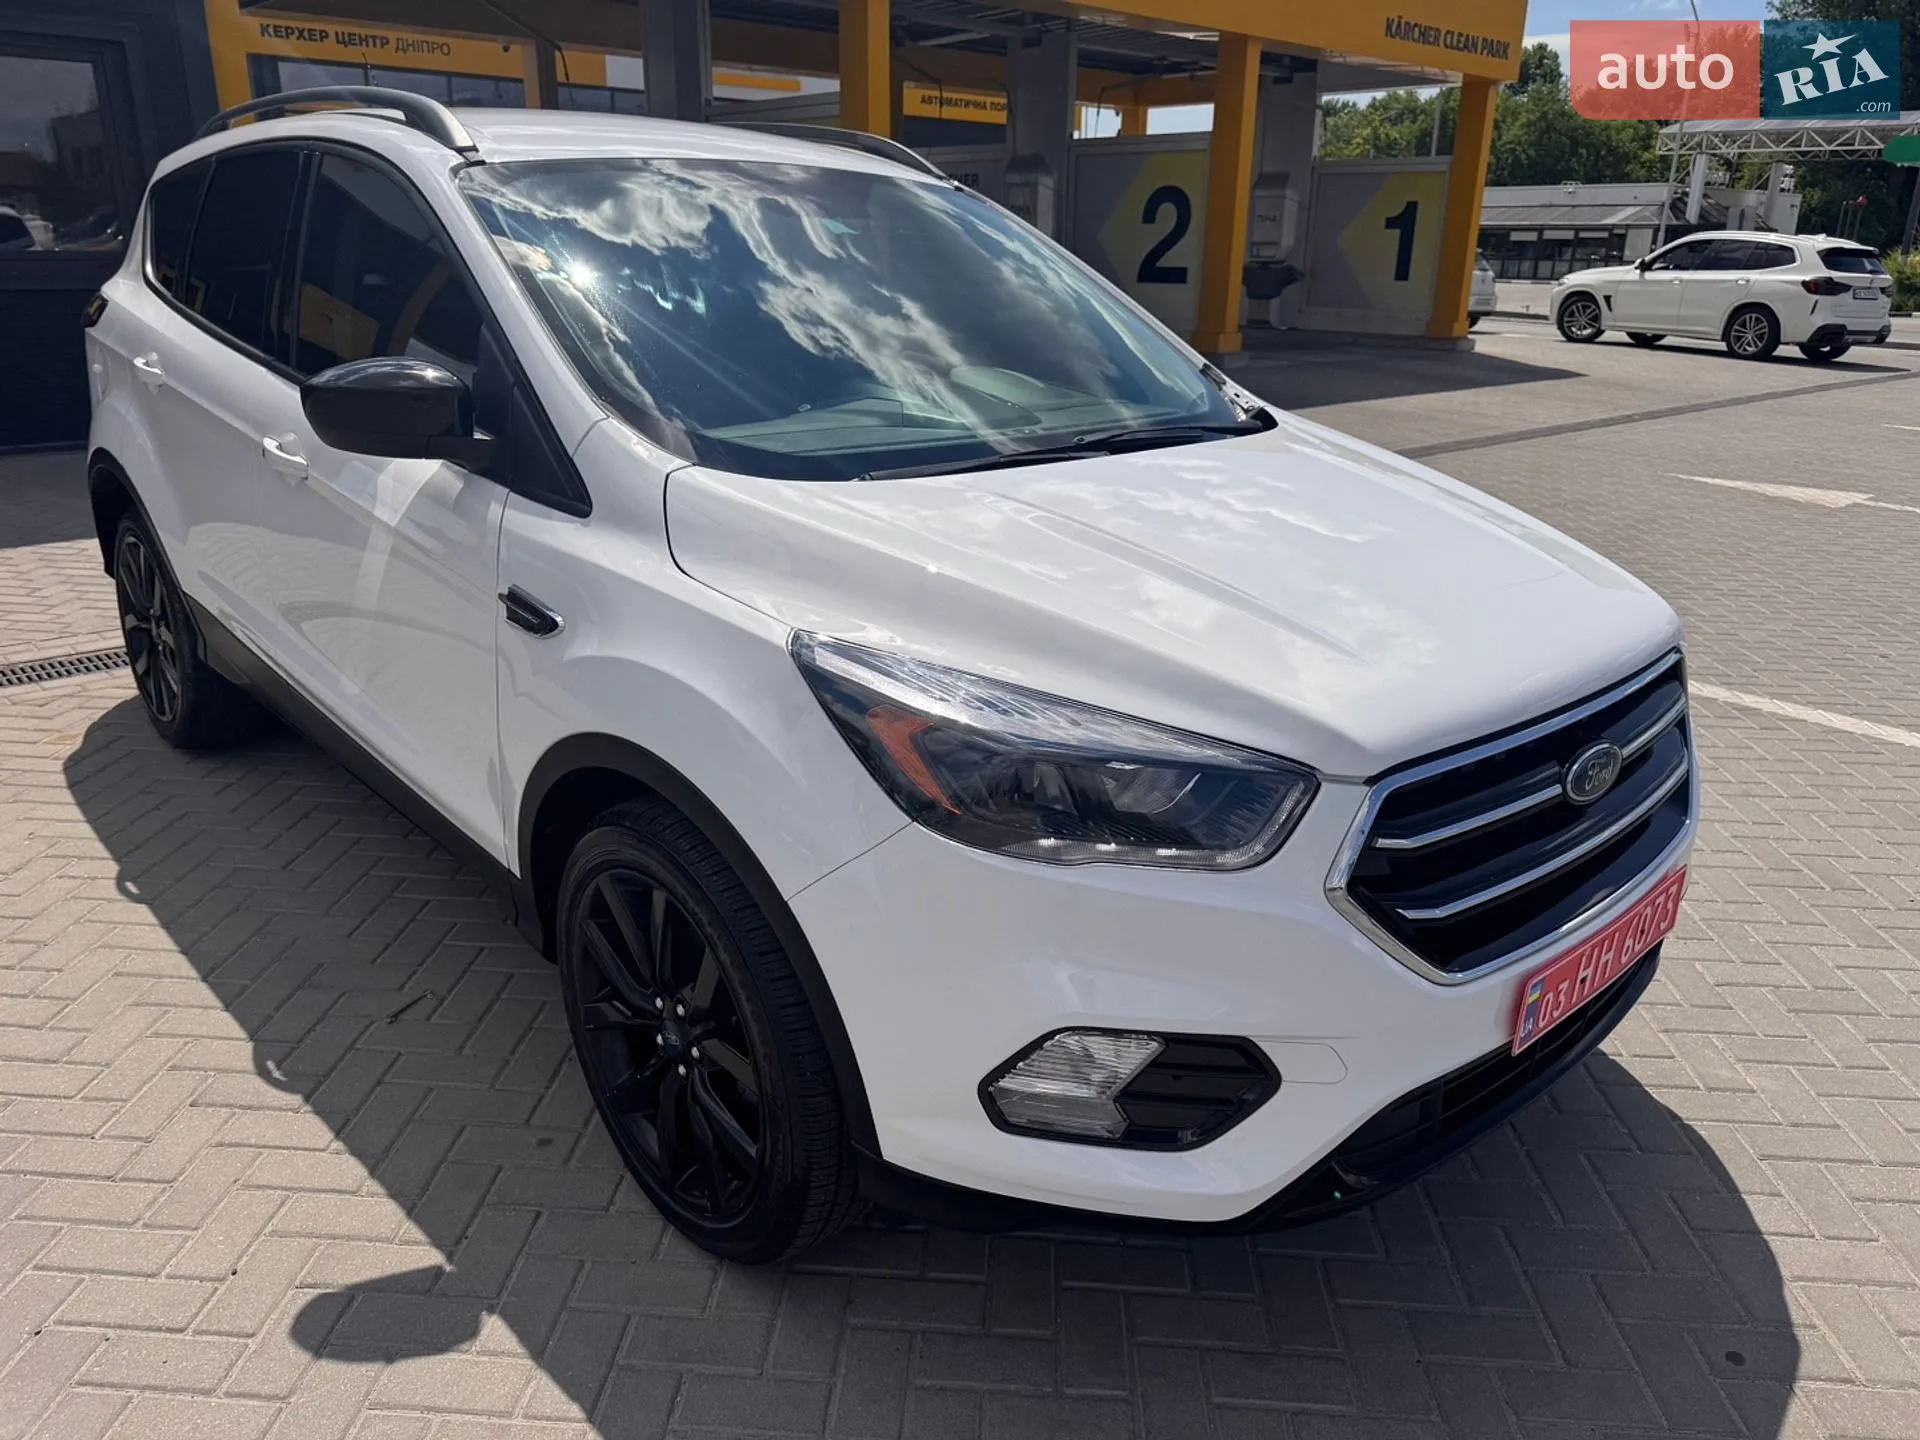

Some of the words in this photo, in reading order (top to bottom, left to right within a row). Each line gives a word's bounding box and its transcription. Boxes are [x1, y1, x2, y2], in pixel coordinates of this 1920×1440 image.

[260, 23, 329, 43] КЕРХЕР
[335, 30, 389, 48] ЦЕНТР
[395, 38, 450, 56] ДНІПРО
[1384, 15, 1441, 47] KÄRCHER
[1443, 29, 1479, 54] CLEAN
[1480, 37, 1511, 60] PARK
[1137, 185, 1191, 284] 2
[1384, 200, 1418, 281] 1
[1585, 758, 1613, 790] Ford
[1538, 978, 1569, 1029] 03
[1620, 882, 1679, 965] 6073
